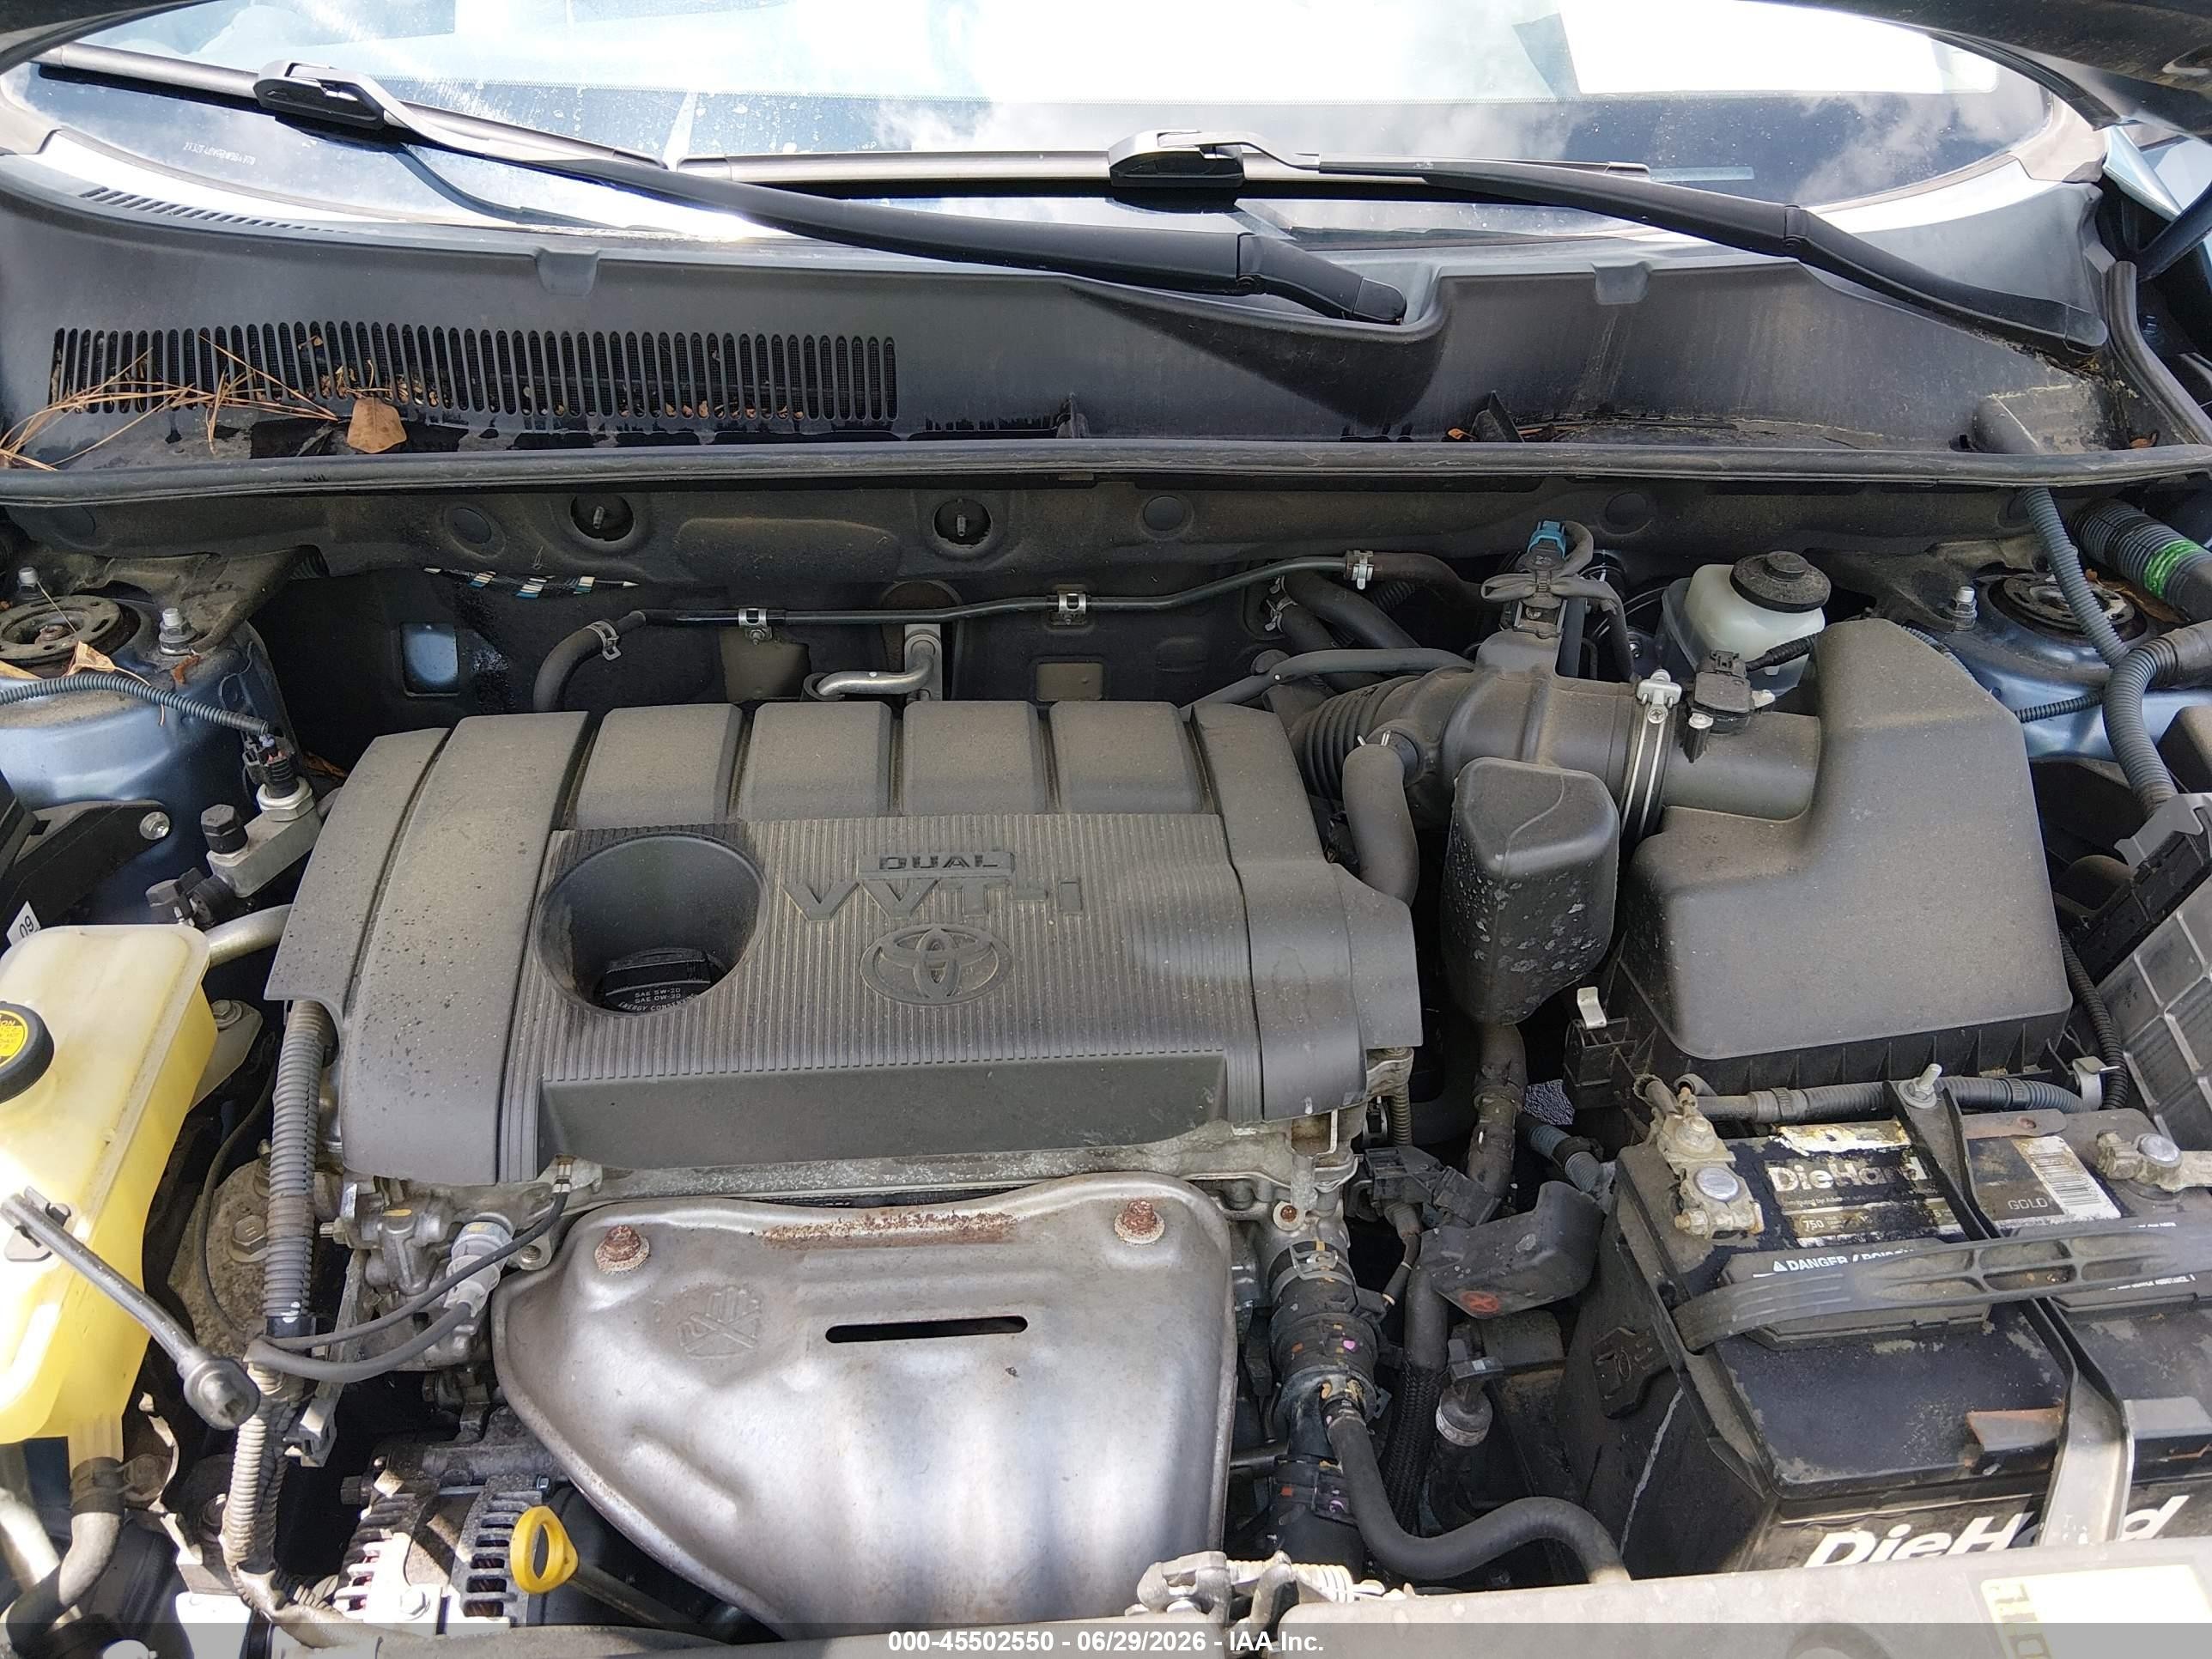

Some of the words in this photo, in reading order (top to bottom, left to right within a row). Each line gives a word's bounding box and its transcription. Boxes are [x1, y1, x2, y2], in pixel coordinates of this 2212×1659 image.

[878, 854, 999, 869] DUAL
[618, 1001, 648, 1012] ENERGY
[1768, 1157, 1928, 1192] DieHad
[2008, 1197, 2048, 1210] GOLD
[1802, 1219, 1825, 1231] 750
[1803, 1495, 2190, 1569] DieHd
